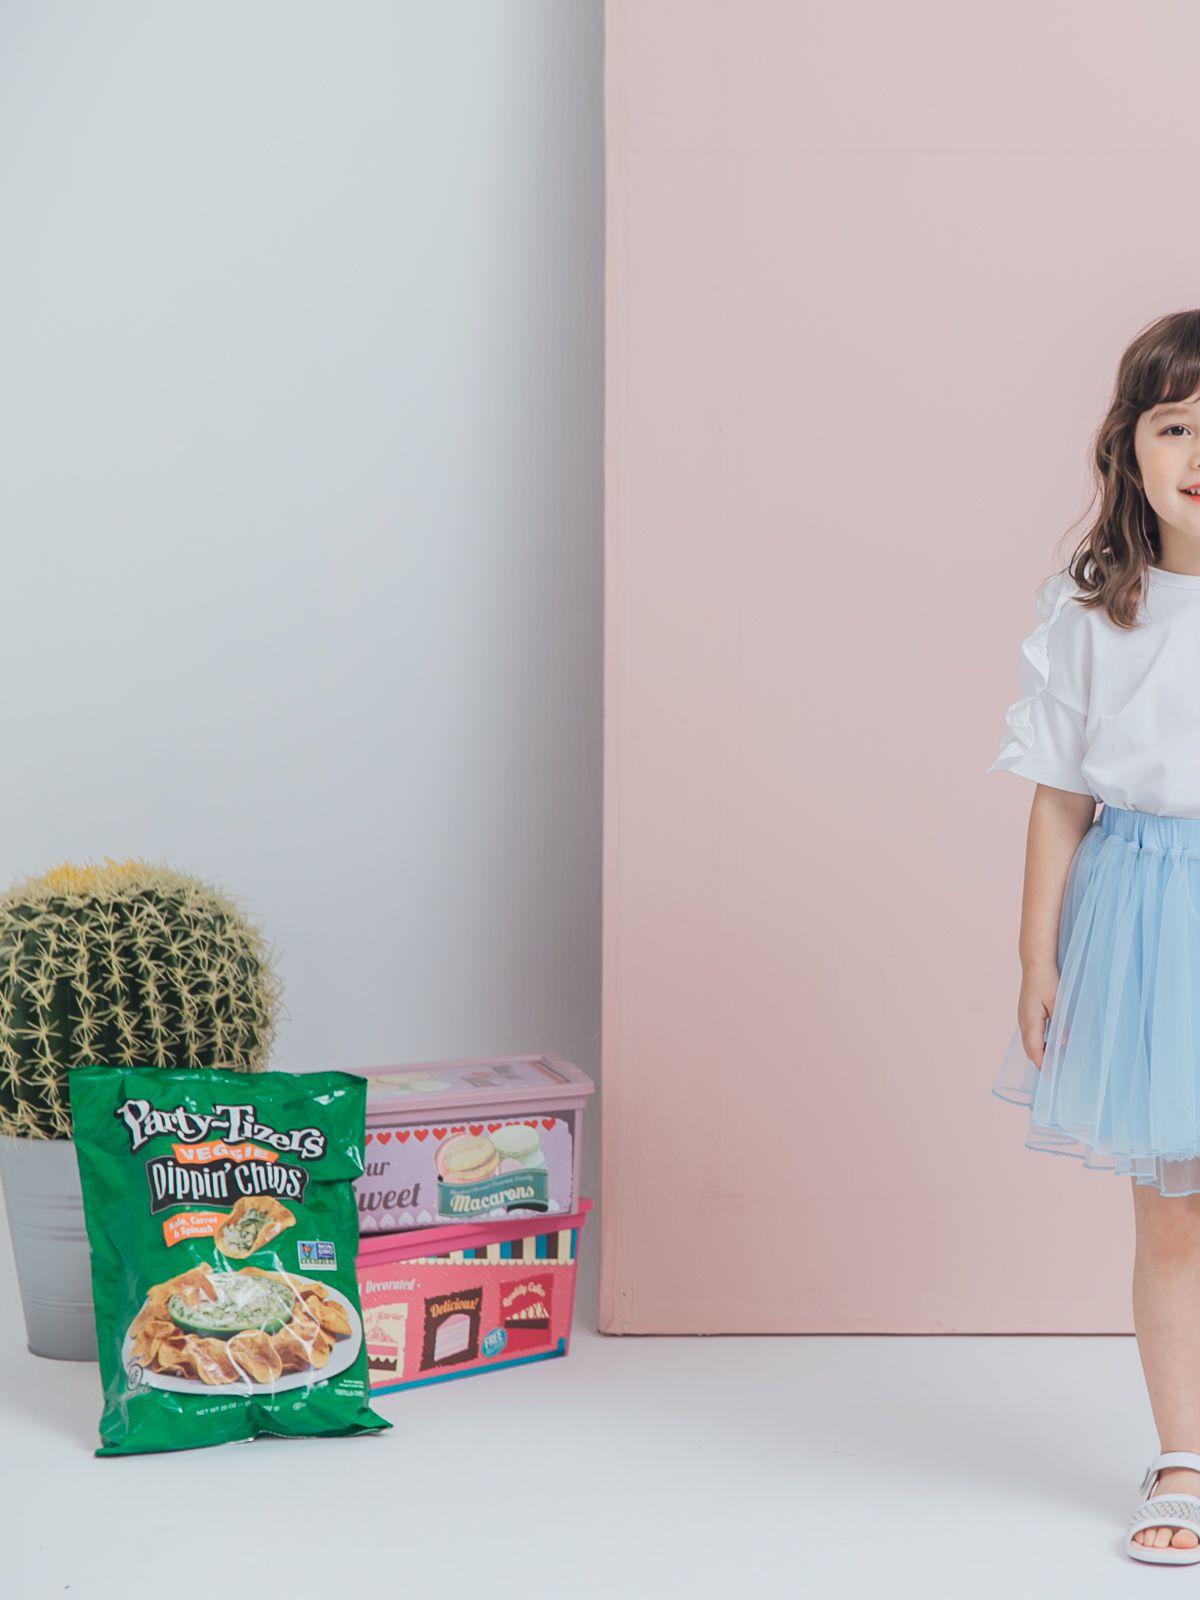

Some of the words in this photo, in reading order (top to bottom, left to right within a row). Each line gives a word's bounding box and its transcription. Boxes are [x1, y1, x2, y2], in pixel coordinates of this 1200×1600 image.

[116, 1100, 325, 1159] Party-Tizers
[179, 1145, 271, 1161] VEGGIE
[152, 1160, 231, 1201] Dippin'
[364, 1162, 390, 1177] ur
[352, 1183, 422, 1212] weet
[449, 1186, 536, 1212] Macarons
[430, 1298, 480, 1319] Delicious!
